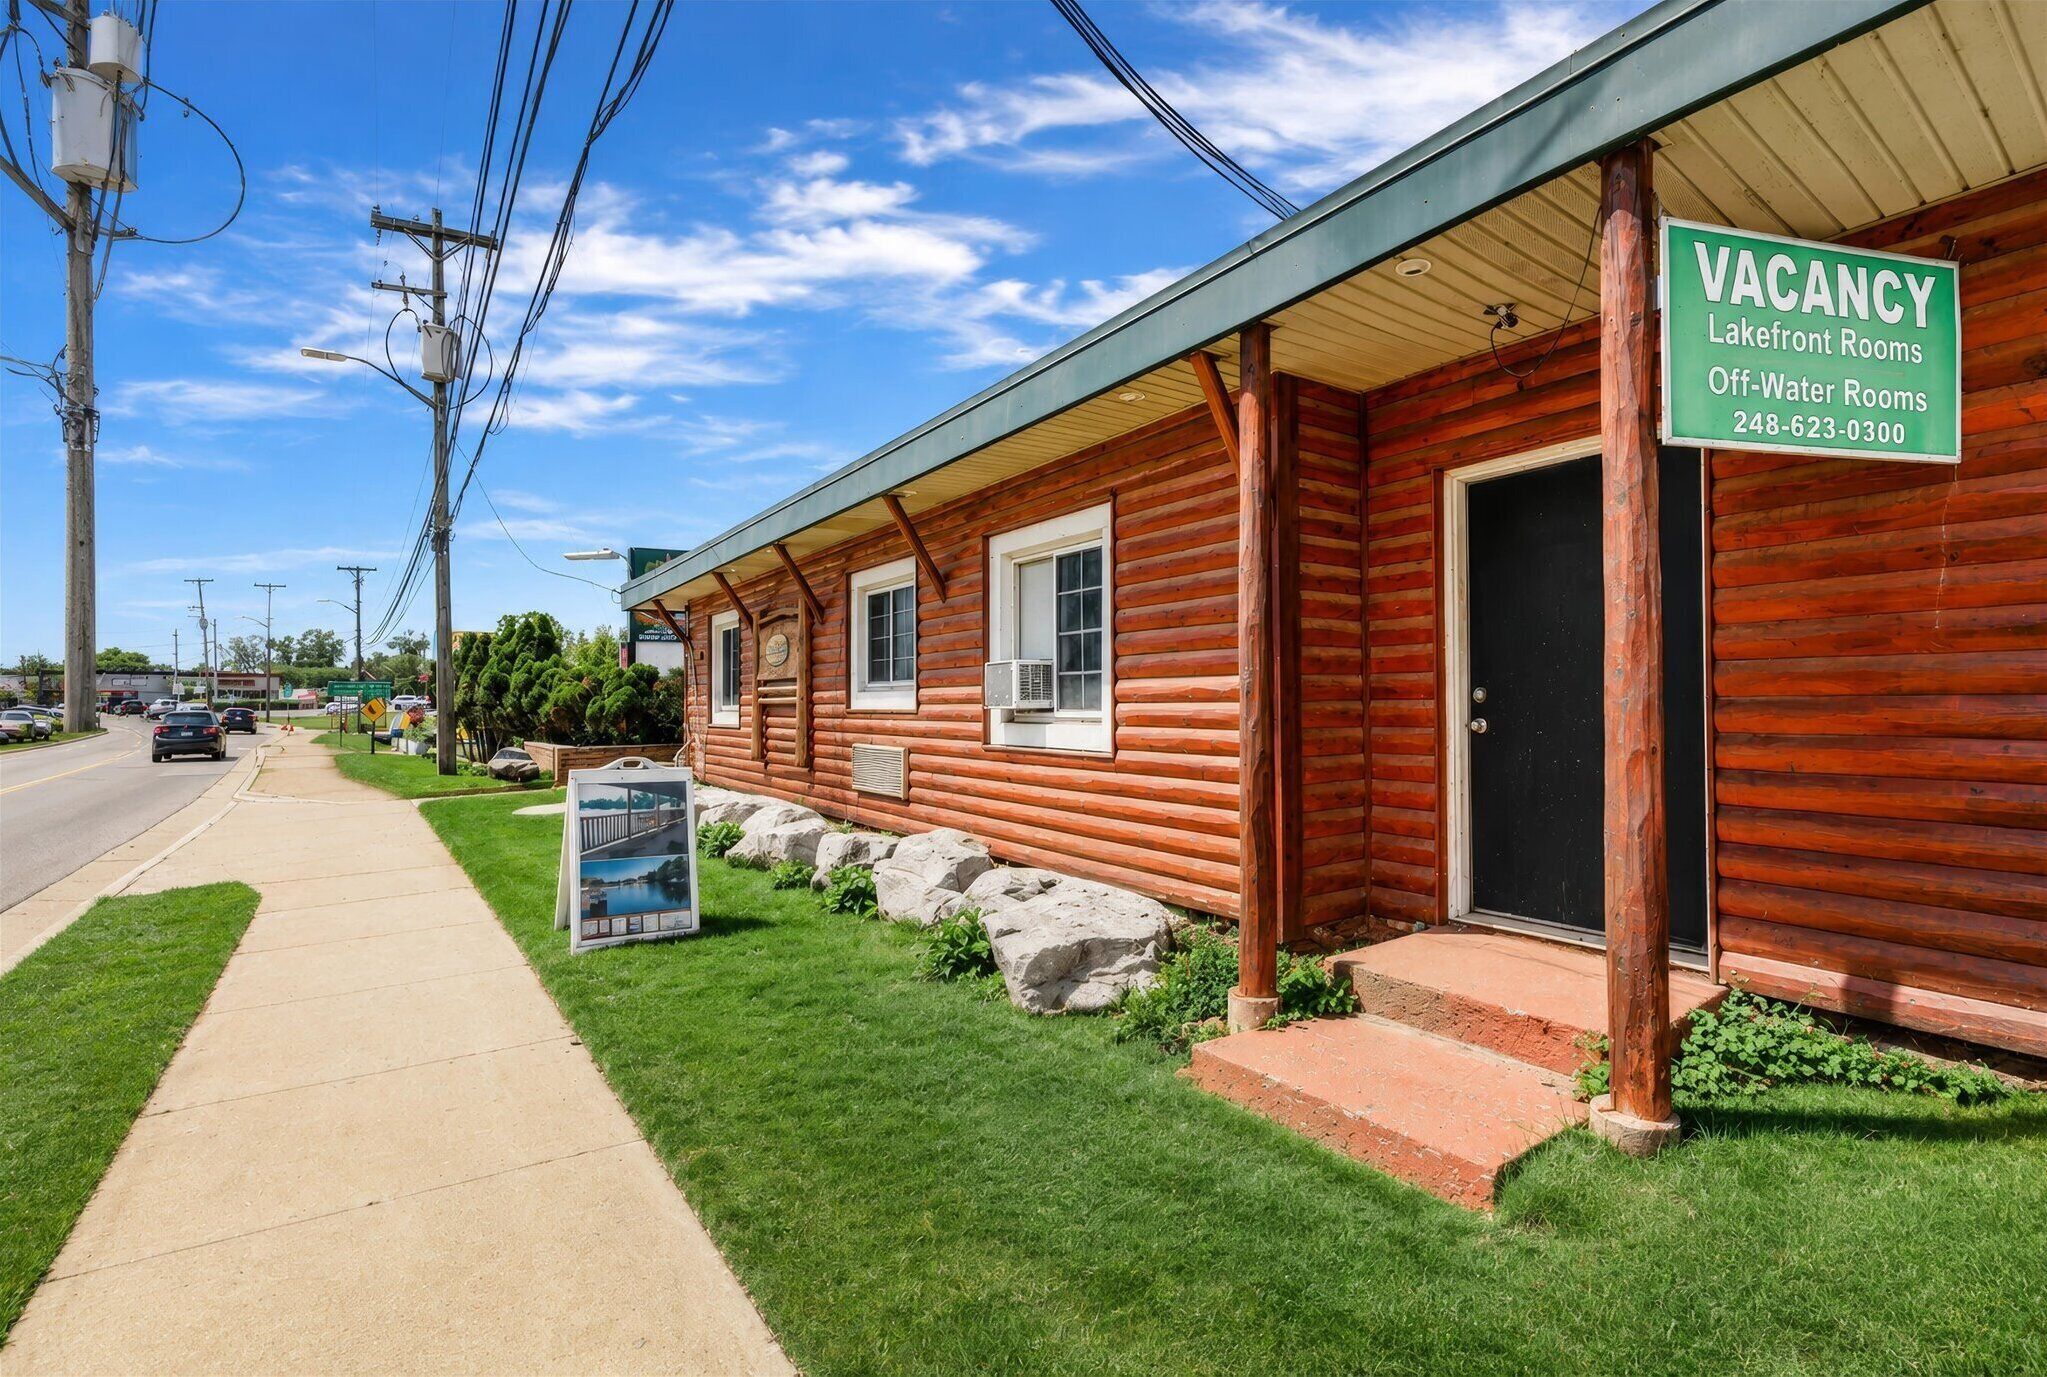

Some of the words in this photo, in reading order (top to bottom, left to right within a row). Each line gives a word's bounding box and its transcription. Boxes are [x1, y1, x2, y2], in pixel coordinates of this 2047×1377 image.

[1693, 241, 1936, 328] VACANCY
[1708, 313, 1832, 355] Lakefront
[1841, 328, 1923, 364] Rooms
[1708, 366, 1835, 404] Off-Water
[1844, 379, 1928, 412] Rooms
[1733, 410, 1905, 444] 248-623-0300
